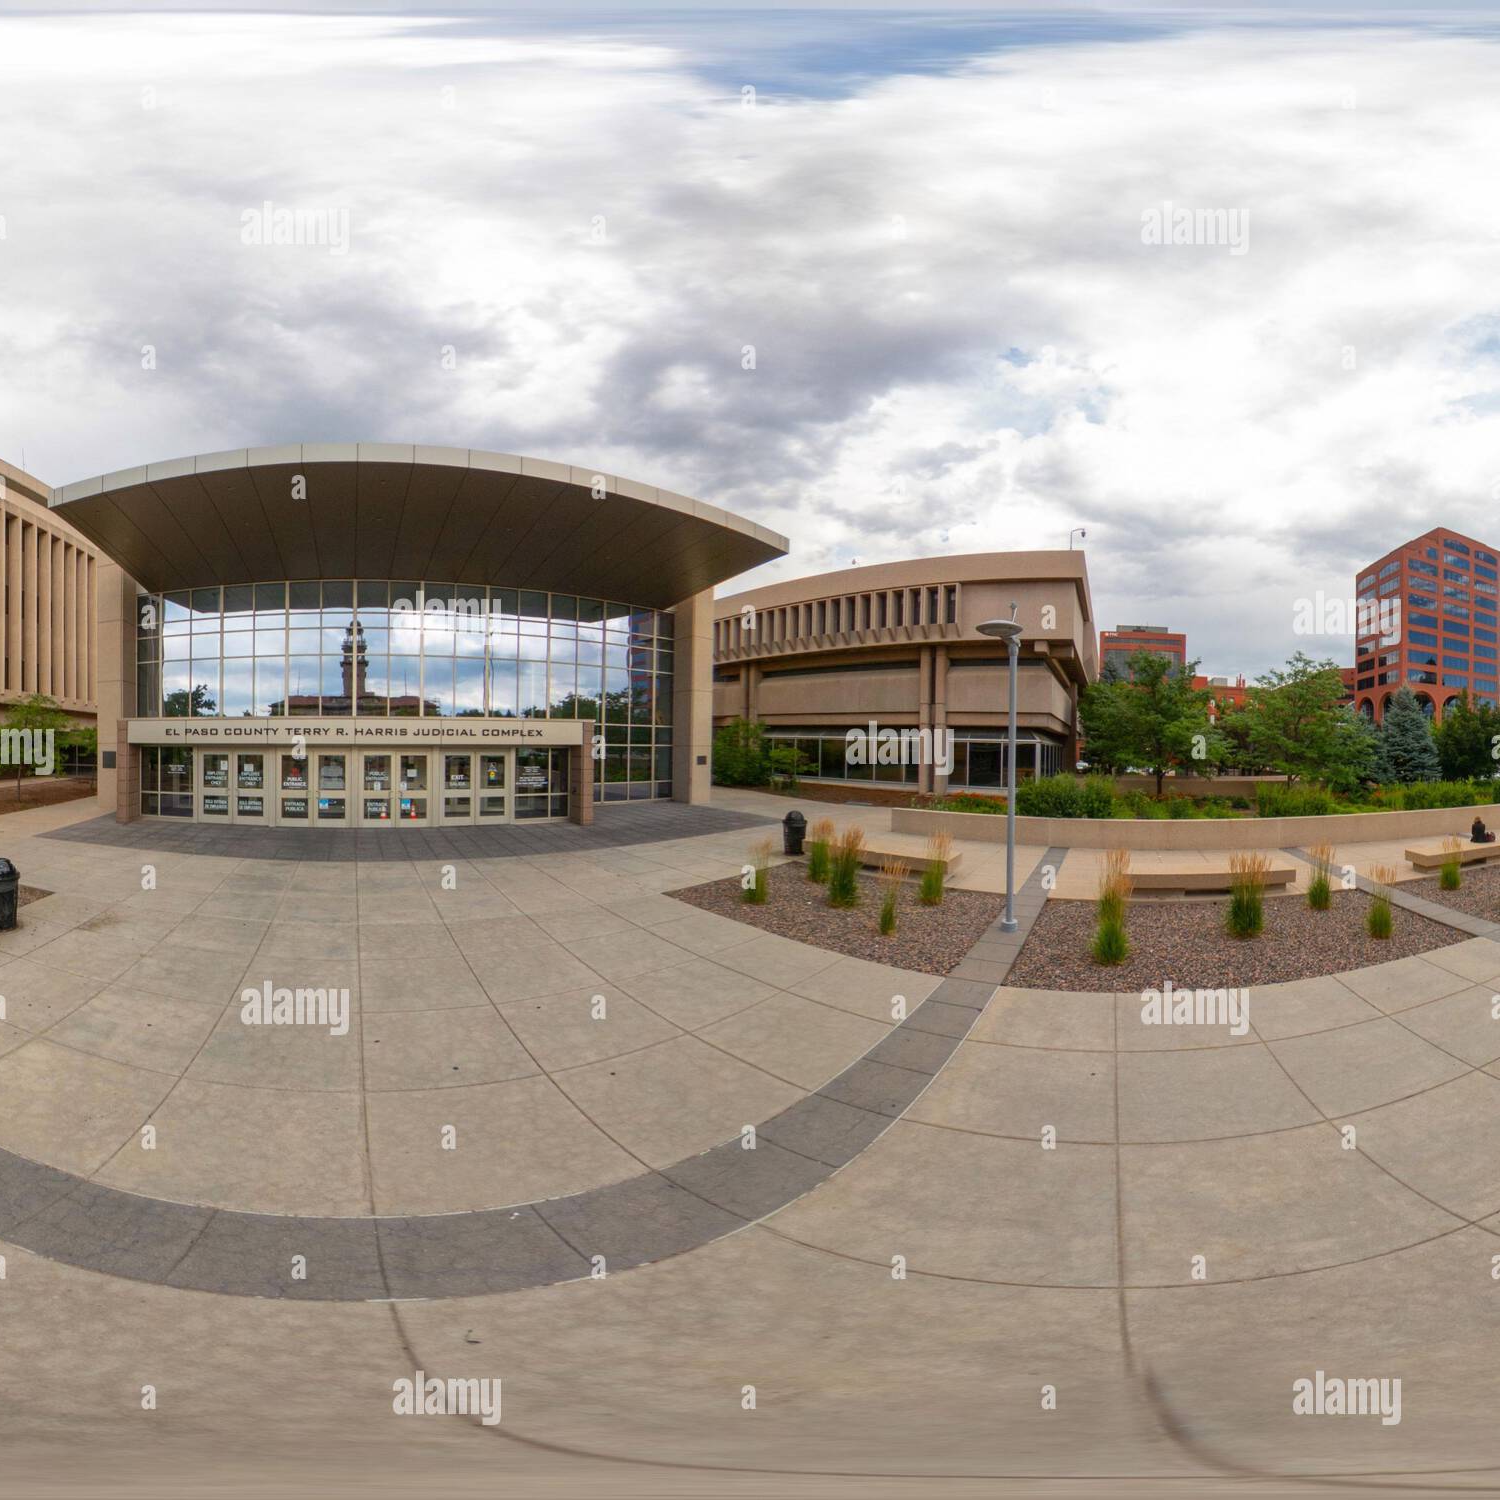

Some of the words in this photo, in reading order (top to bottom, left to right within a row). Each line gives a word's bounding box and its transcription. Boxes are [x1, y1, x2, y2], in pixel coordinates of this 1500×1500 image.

[165, 728, 180, 736] EL
[185, 728, 219, 736] PASO
[224, 727, 279, 736] COUNTY
[285, 727, 330, 736] TERRY
[336, 727, 349, 736] R.
[354, 728, 408, 736] HARRIS
[413, 728, 476, 737] JUDICIAL
[482, 728, 543, 737] COMPLEX
